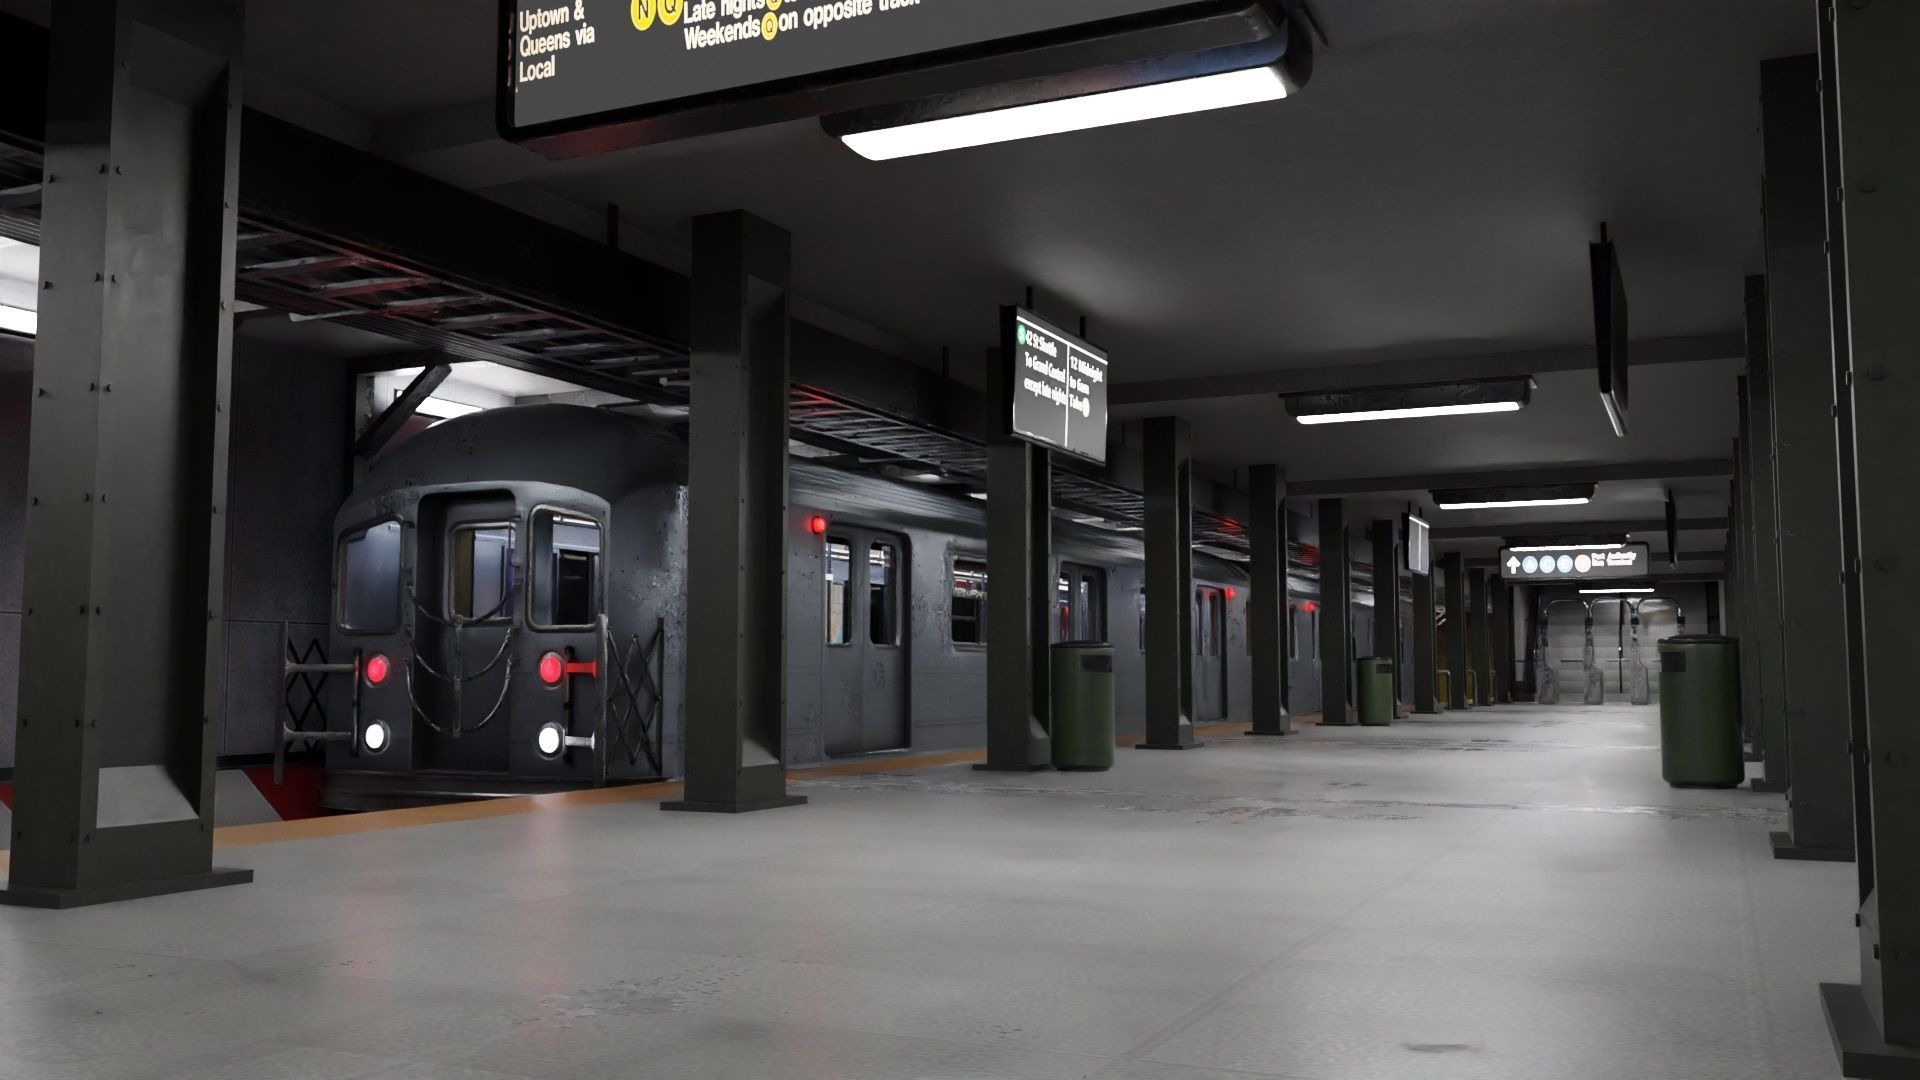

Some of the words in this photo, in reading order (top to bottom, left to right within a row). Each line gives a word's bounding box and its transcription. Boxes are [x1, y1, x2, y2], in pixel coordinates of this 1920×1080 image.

[519, 6, 569, 35] Uptown
[574, 0, 585, 20] &
[683, 1, 717, 24] Late
[683, 15, 760, 50] Weekends
[778, 11, 799, 31] on
[803, 0, 873, 30] opposite
[520, 30, 571, 57] Queens
[575, 22, 595, 45] via
[519, 55, 556, 82] Local
[1024, 351, 1032, 368] To
[1033, 355, 1049, 376] Grand
[1070, 355, 1078, 371] 12
